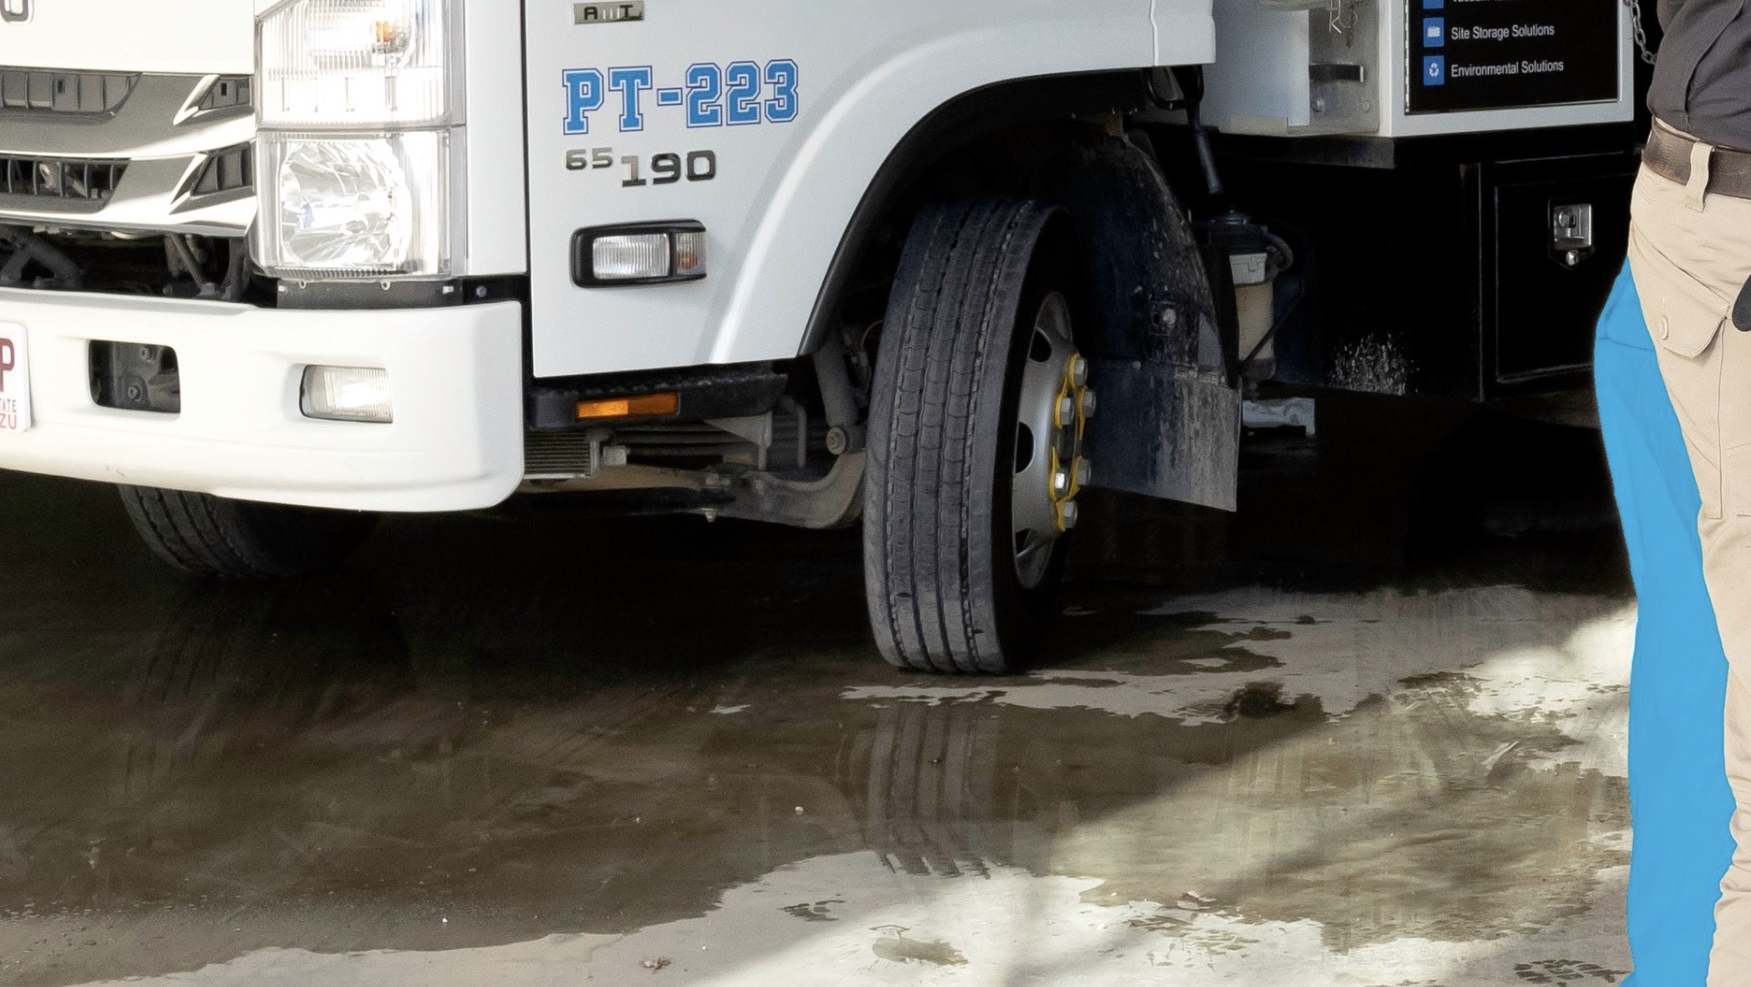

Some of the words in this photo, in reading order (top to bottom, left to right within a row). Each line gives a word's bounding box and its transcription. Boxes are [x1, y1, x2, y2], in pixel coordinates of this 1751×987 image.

[1450, 27, 1470, 40] Site
[1472, 25, 1510, 41] Storage
[1512, 24, 1555, 38] Solutions
[1451, 61, 1519, 78] Environmental
[1521, 60, 1564, 74] Solutions
[561, 58, 799, 136] PT-223
[565, 146, 614, 171] 65
[621, 149, 717, 188] 190
